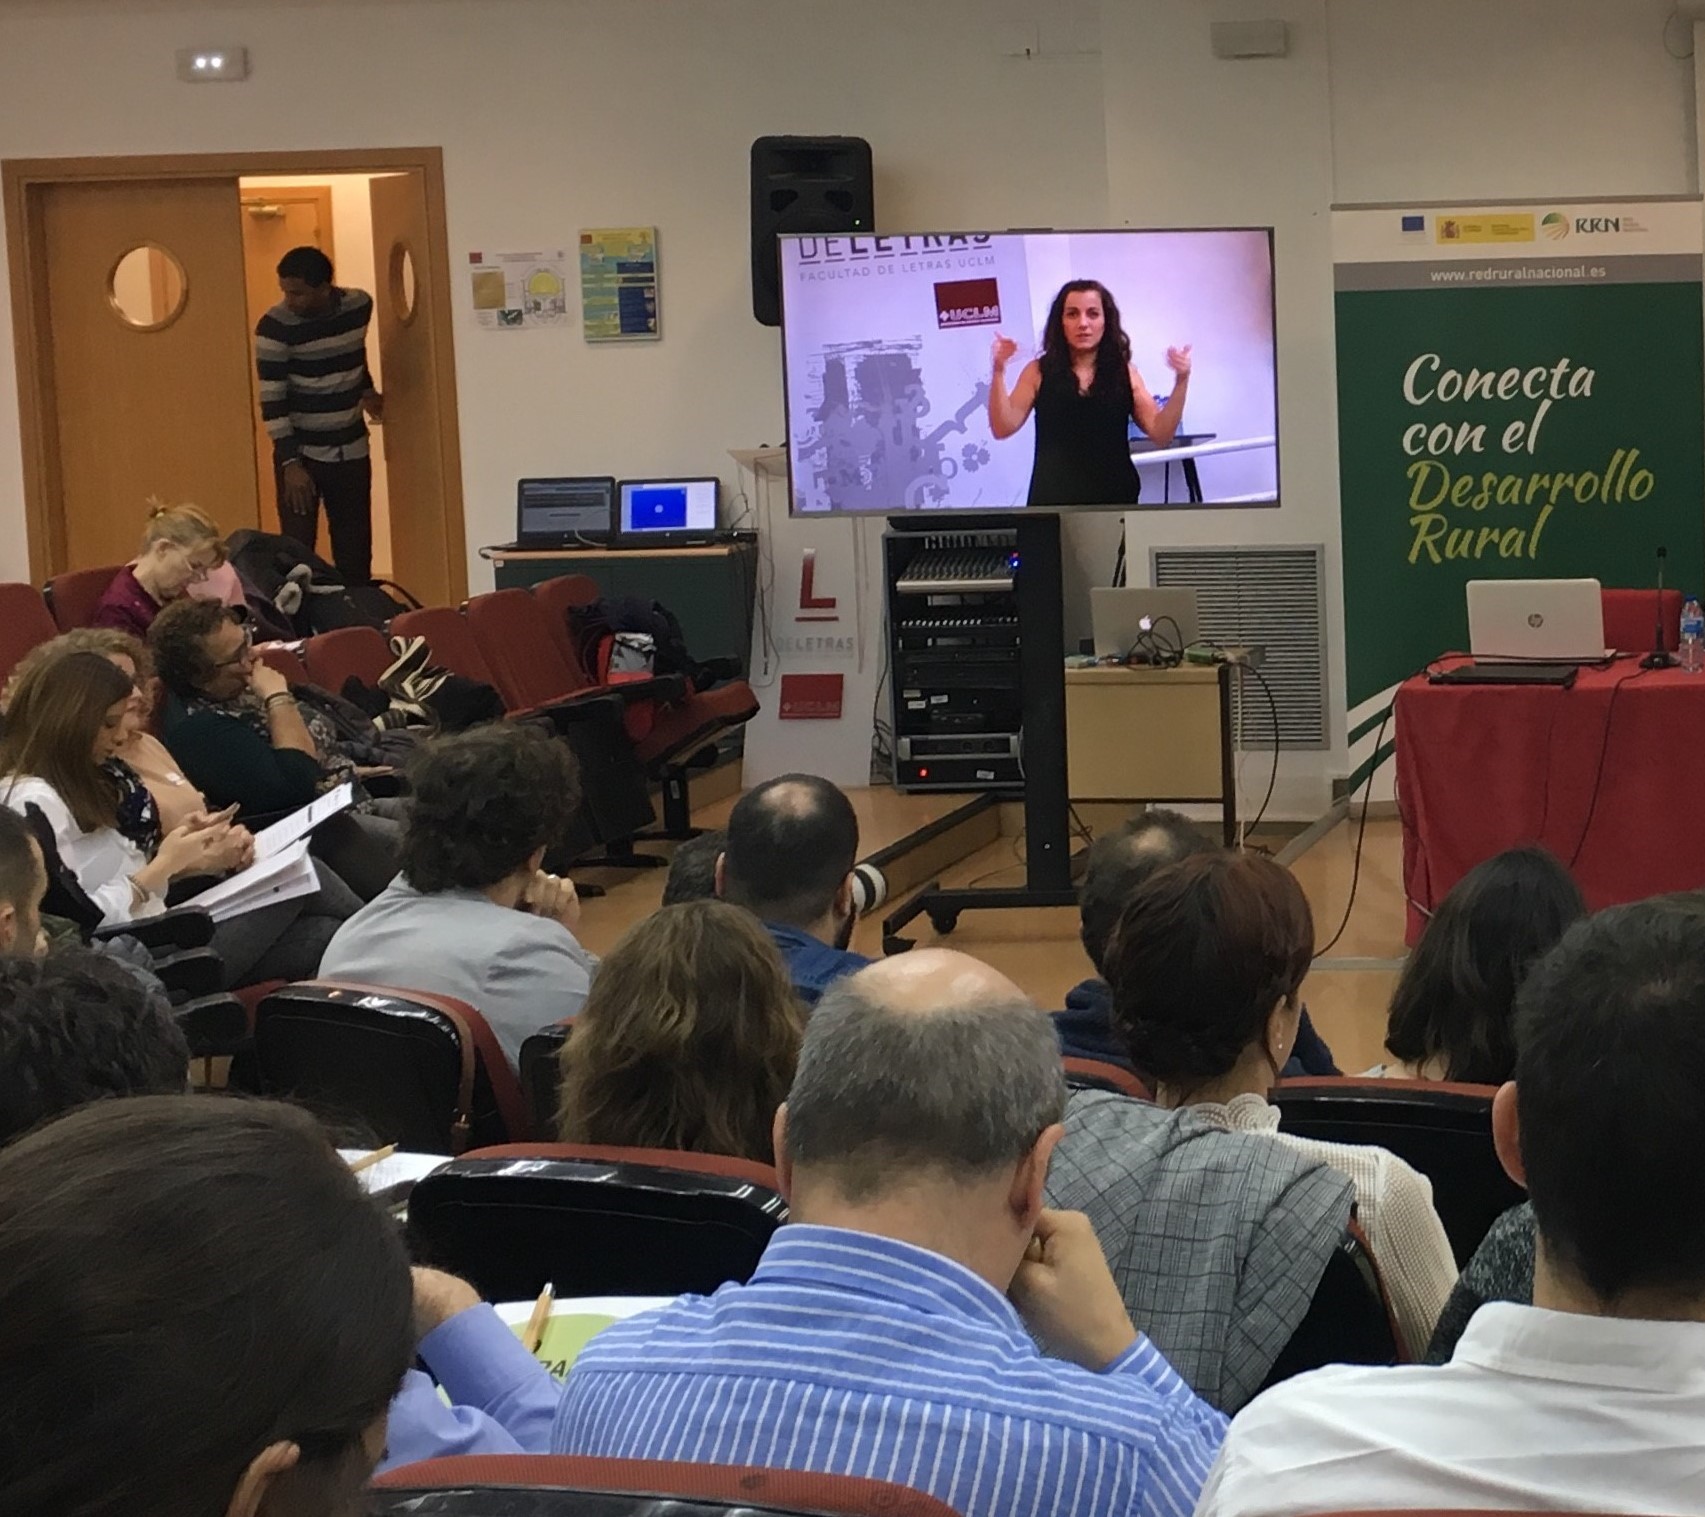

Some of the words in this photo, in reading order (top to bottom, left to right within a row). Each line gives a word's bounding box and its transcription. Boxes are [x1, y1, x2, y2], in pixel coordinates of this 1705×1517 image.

[1575, 217, 1620, 234] RRN
[799, 266, 871, 282] FACULTAD
[877, 264, 895, 276] DE
[902, 259, 951, 273] LETRAS
[958, 255, 995, 268] UCLM
[1430, 264, 1606, 282] www.redruralnacional.es
[950, 305, 999, 321] UCLM
[1403, 353, 1596, 405] Conecta
[1402, 421, 1487, 456] con
[1502, 398, 1553, 455] el
[1407, 448, 1655, 511] Desarrollo
[1407, 504, 1554, 564] Rural
[800, 548, 837, 609] L
